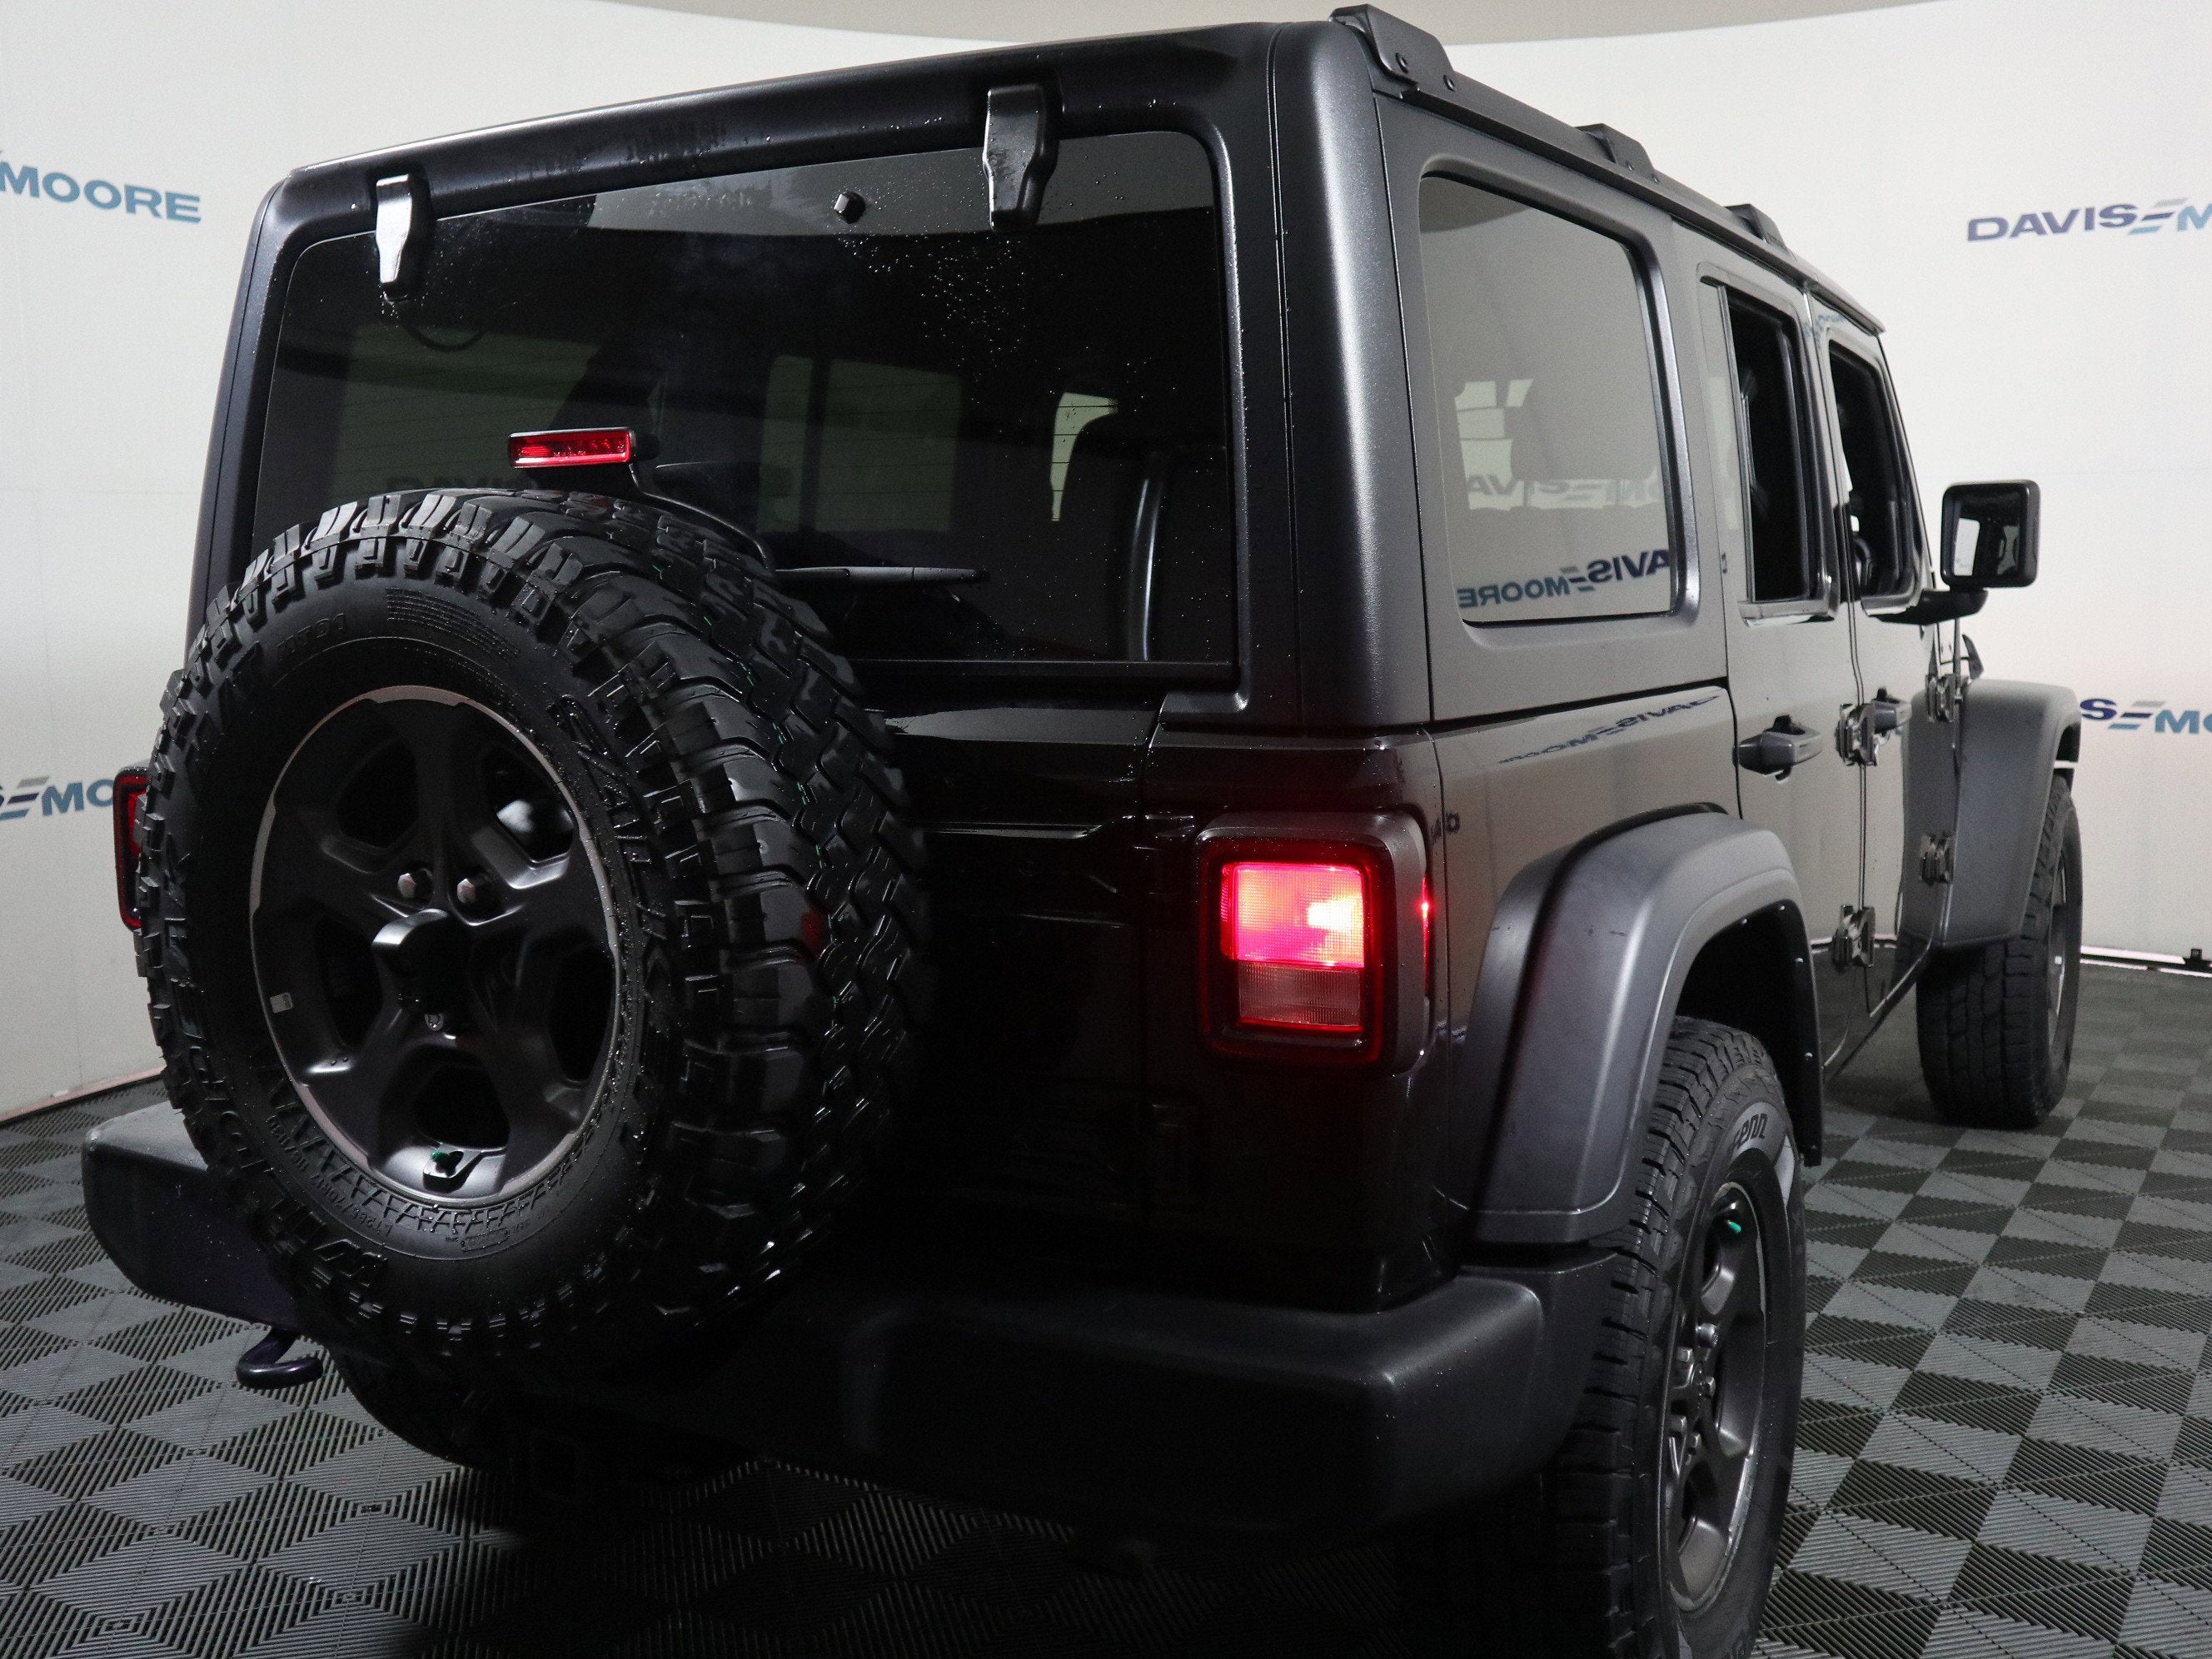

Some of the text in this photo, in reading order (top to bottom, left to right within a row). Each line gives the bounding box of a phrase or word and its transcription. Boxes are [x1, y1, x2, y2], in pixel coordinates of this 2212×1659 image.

[0, 161, 202, 223] MOORE
[1967, 204, 2138, 242] DAVIS
[2155, 710, 2212, 735] M
